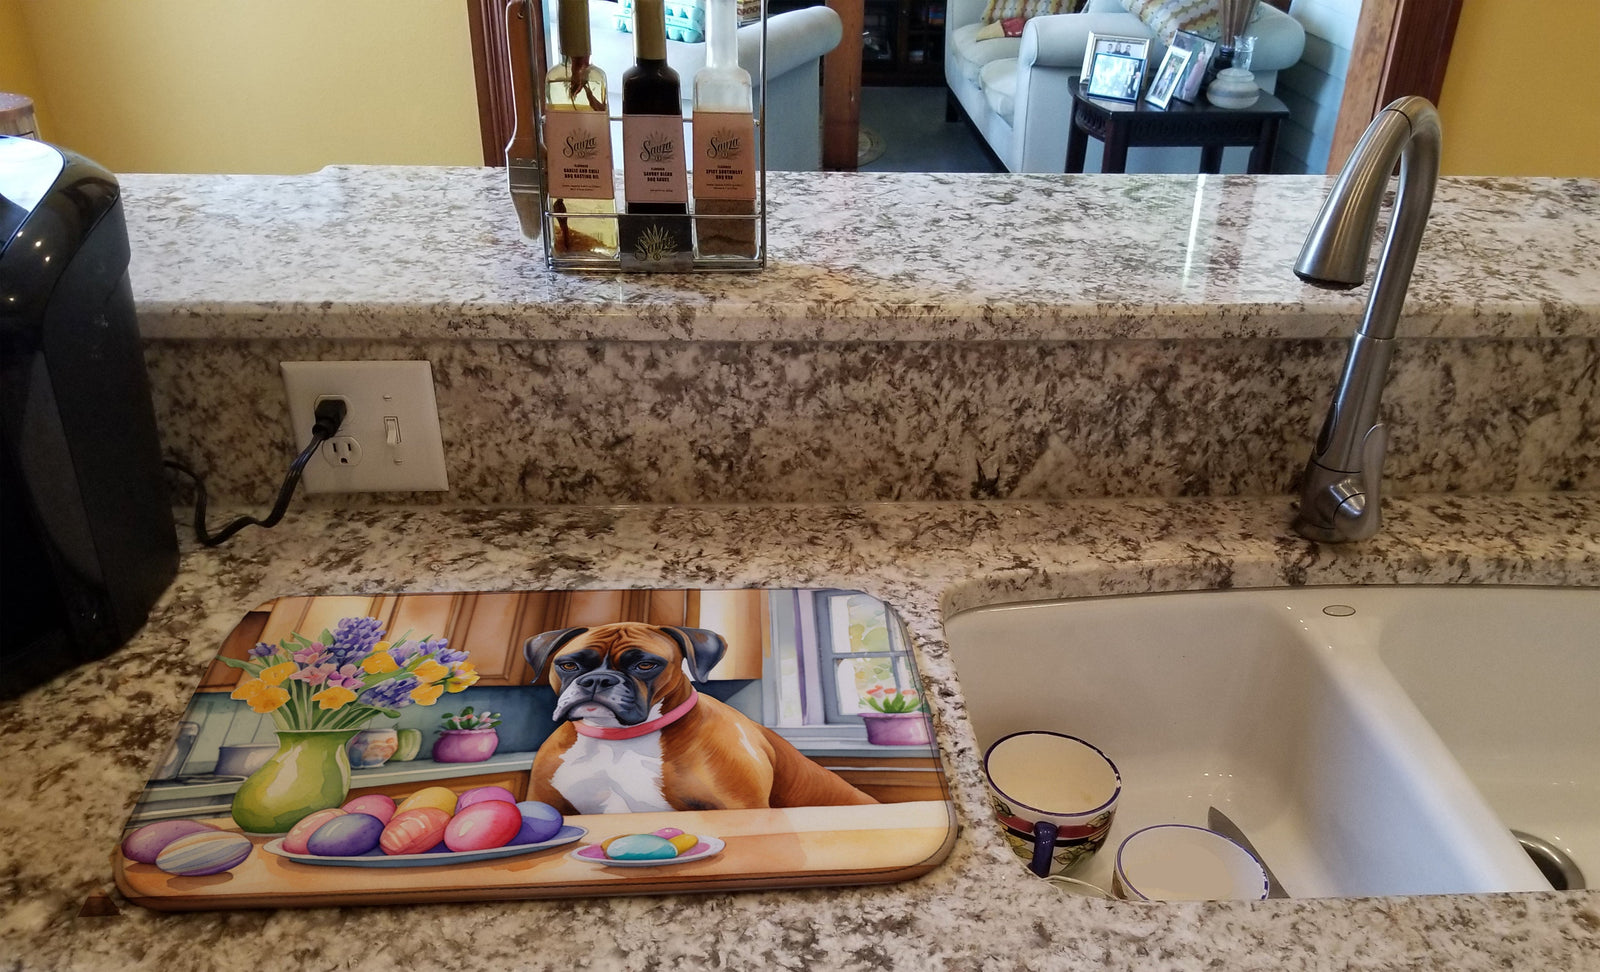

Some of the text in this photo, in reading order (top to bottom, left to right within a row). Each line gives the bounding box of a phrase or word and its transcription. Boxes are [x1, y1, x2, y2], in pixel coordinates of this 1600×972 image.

[563, 136, 597, 158] Sauza
[640, 140, 674, 161] Sauza
[707, 137, 740, 158] Sauza
